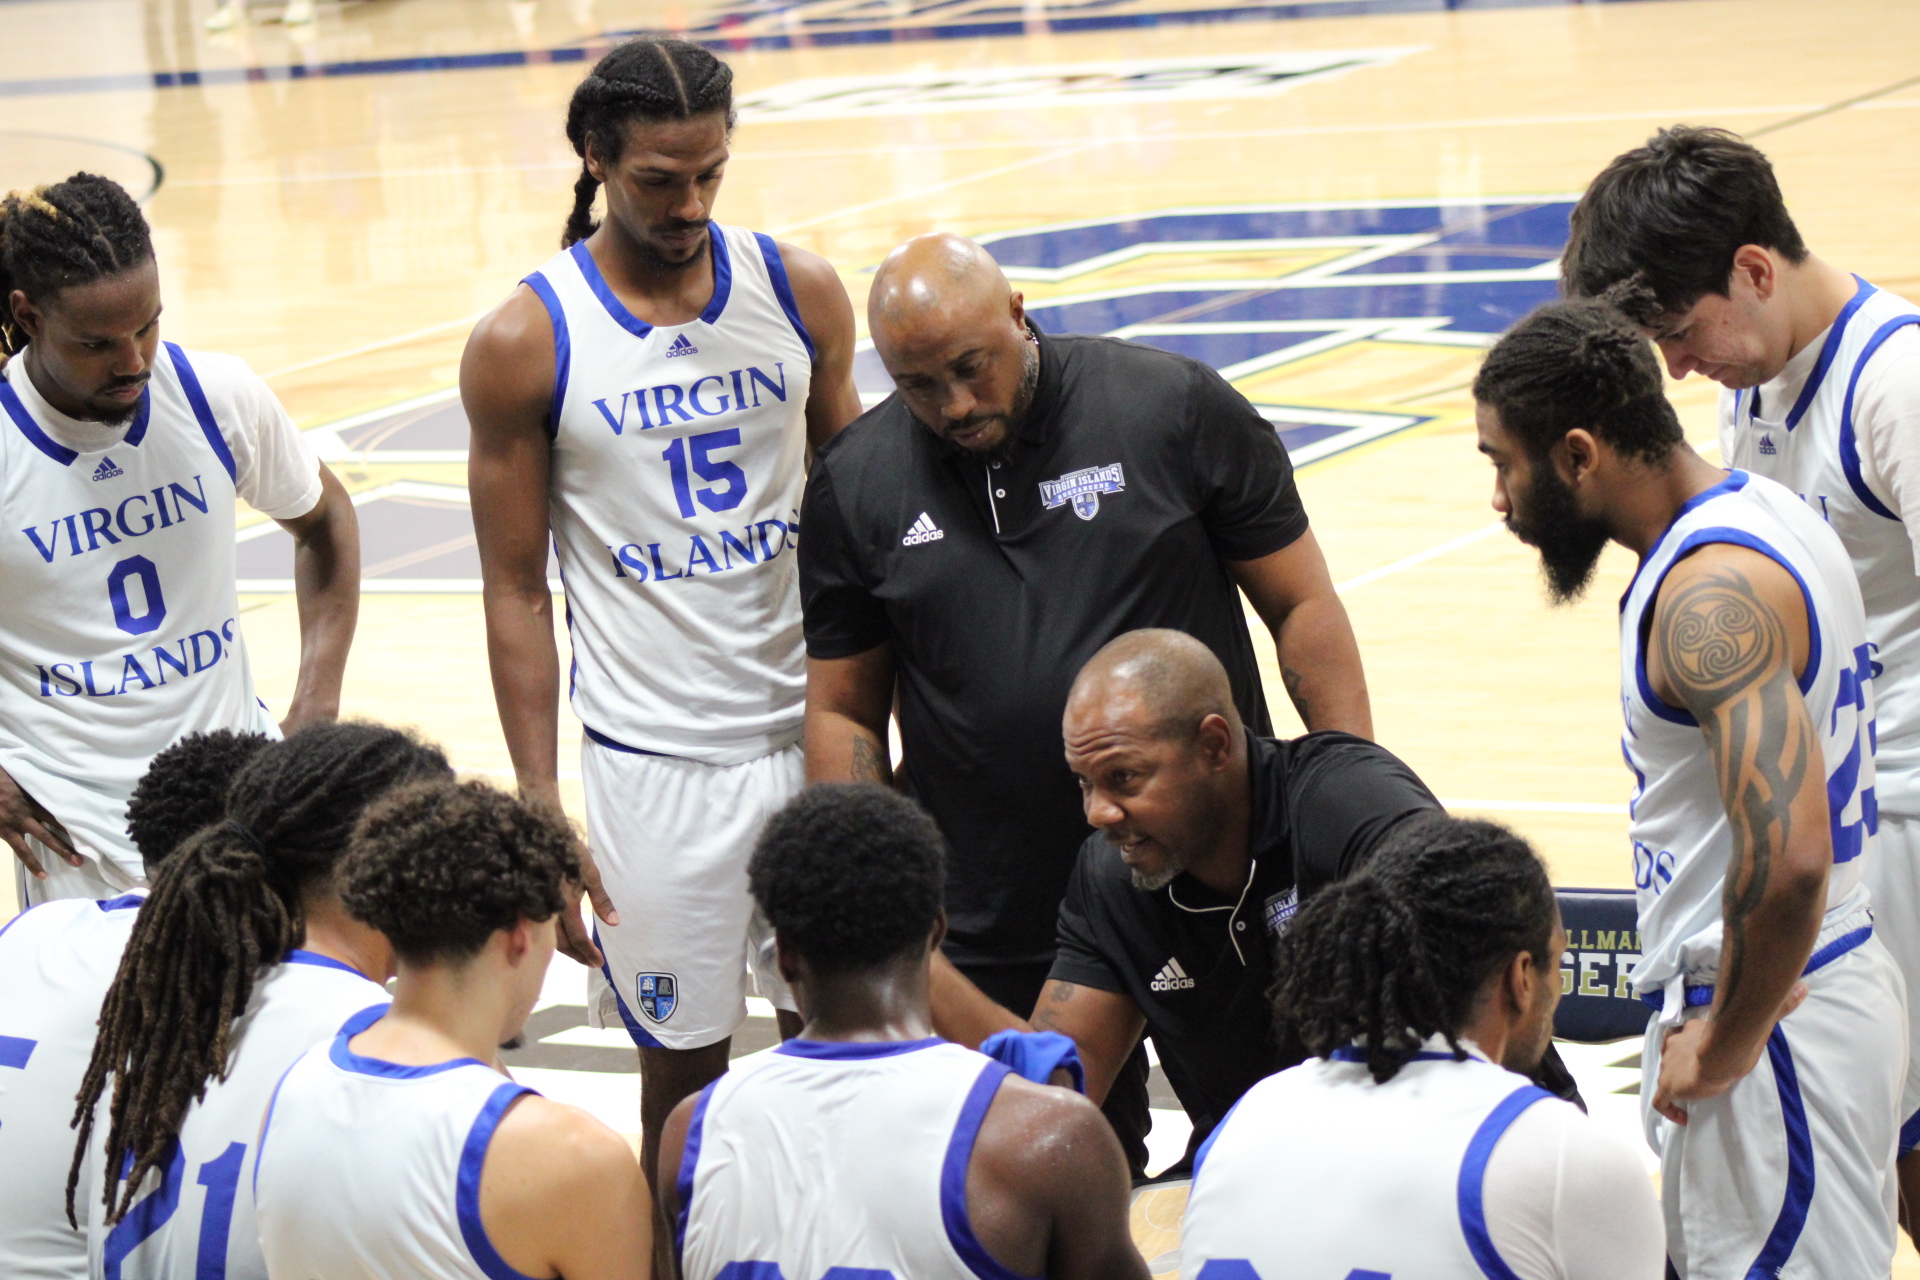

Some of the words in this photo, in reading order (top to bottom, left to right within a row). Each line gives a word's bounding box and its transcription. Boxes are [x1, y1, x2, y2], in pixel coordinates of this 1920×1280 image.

[665, 346, 698, 358] adidas
[591, 362, 787, 436] VIRGIN
[92, 467, 124, 482] adidas
[662, 427, 748, 519] 15
[1042, 478, 1077, 500] VIRGIN
[1077, 467, 1120, 486] ISLANDS
[1057, 482, 1110, 500] BUCCANEERS
[22, 475, 209, 563] VIRGIN
[902, 529, 944, 546] adidas
[107, 554, 167, 636] 0
[1565, 929, 1642, 950] LLMA
[1150, 977, 1195, 992] adidas
